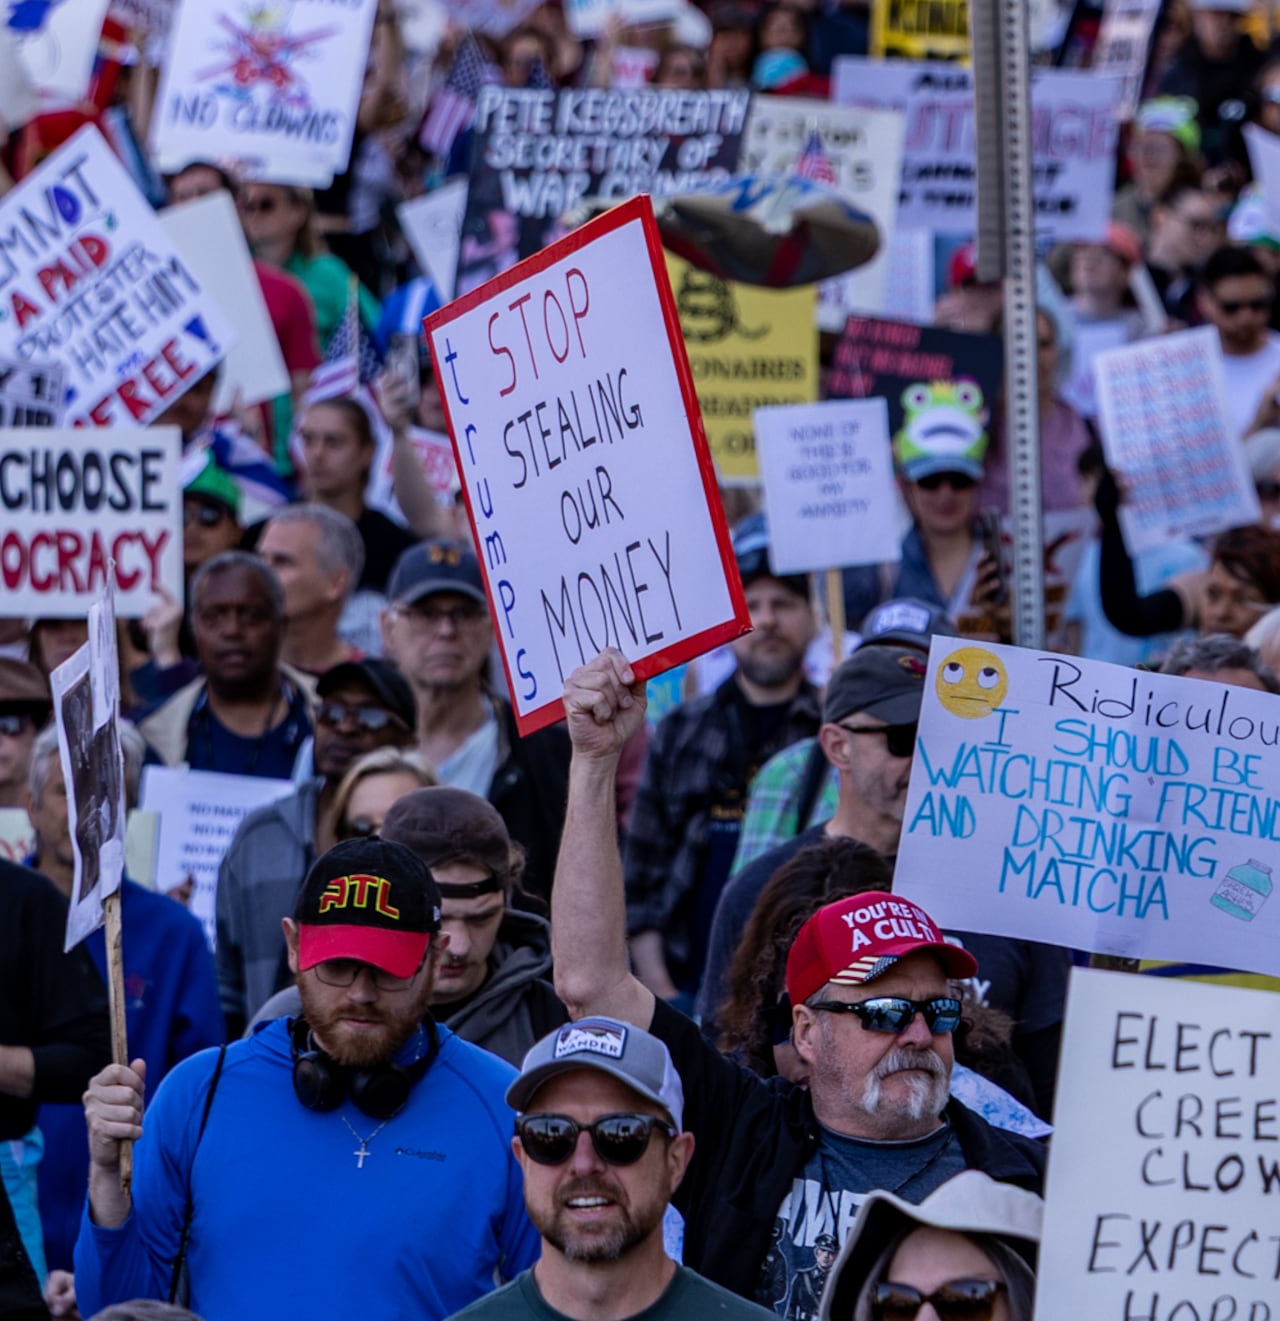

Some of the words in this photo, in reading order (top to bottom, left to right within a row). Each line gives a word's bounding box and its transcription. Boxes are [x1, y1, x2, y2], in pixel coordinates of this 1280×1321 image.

[169, 93, 219, 129] NO
[232, 101, 341, 146] CLOWNS
[478, 86, 555, 132] PETE
[487, 133, 669, 174] SECRETARY
[677, 133, 724, 171] OF
[21, 156, 100, 250] NOT
[500, 169, 592, 218] WAR
[11, 293, 40, 330] A
[37, 234, 108, 303] PAID
[70, 301, 146, 381] HATE
[133, 256, 201, 326] HIM
[488, 267, 590, 397] STOP
[503, 367, 645, 488] STEALING
[561, 465, 624, 545] OUR
[540, 530, 683, 684] MONEY
[917, 736, 1132, 818] WATCHING
[980, 708, 1020, 748] I
[1053, 718, 1190, 776] SHOULD
[1213, 746, 1264, 791] BE
[908, 790, 976, 840] AND
[1012, 803, 1219, 879] DRINKING
[319, 873, 400, 921] ATL
[841, 900, 914, 929] YOU'RE
[998, 847, 1170, 921] MATCHA
[851, 928, 873, 953] A
[558, 1039, 619, 1054] WANDER
[1111, 1011, 1271, 1078] ELECT
